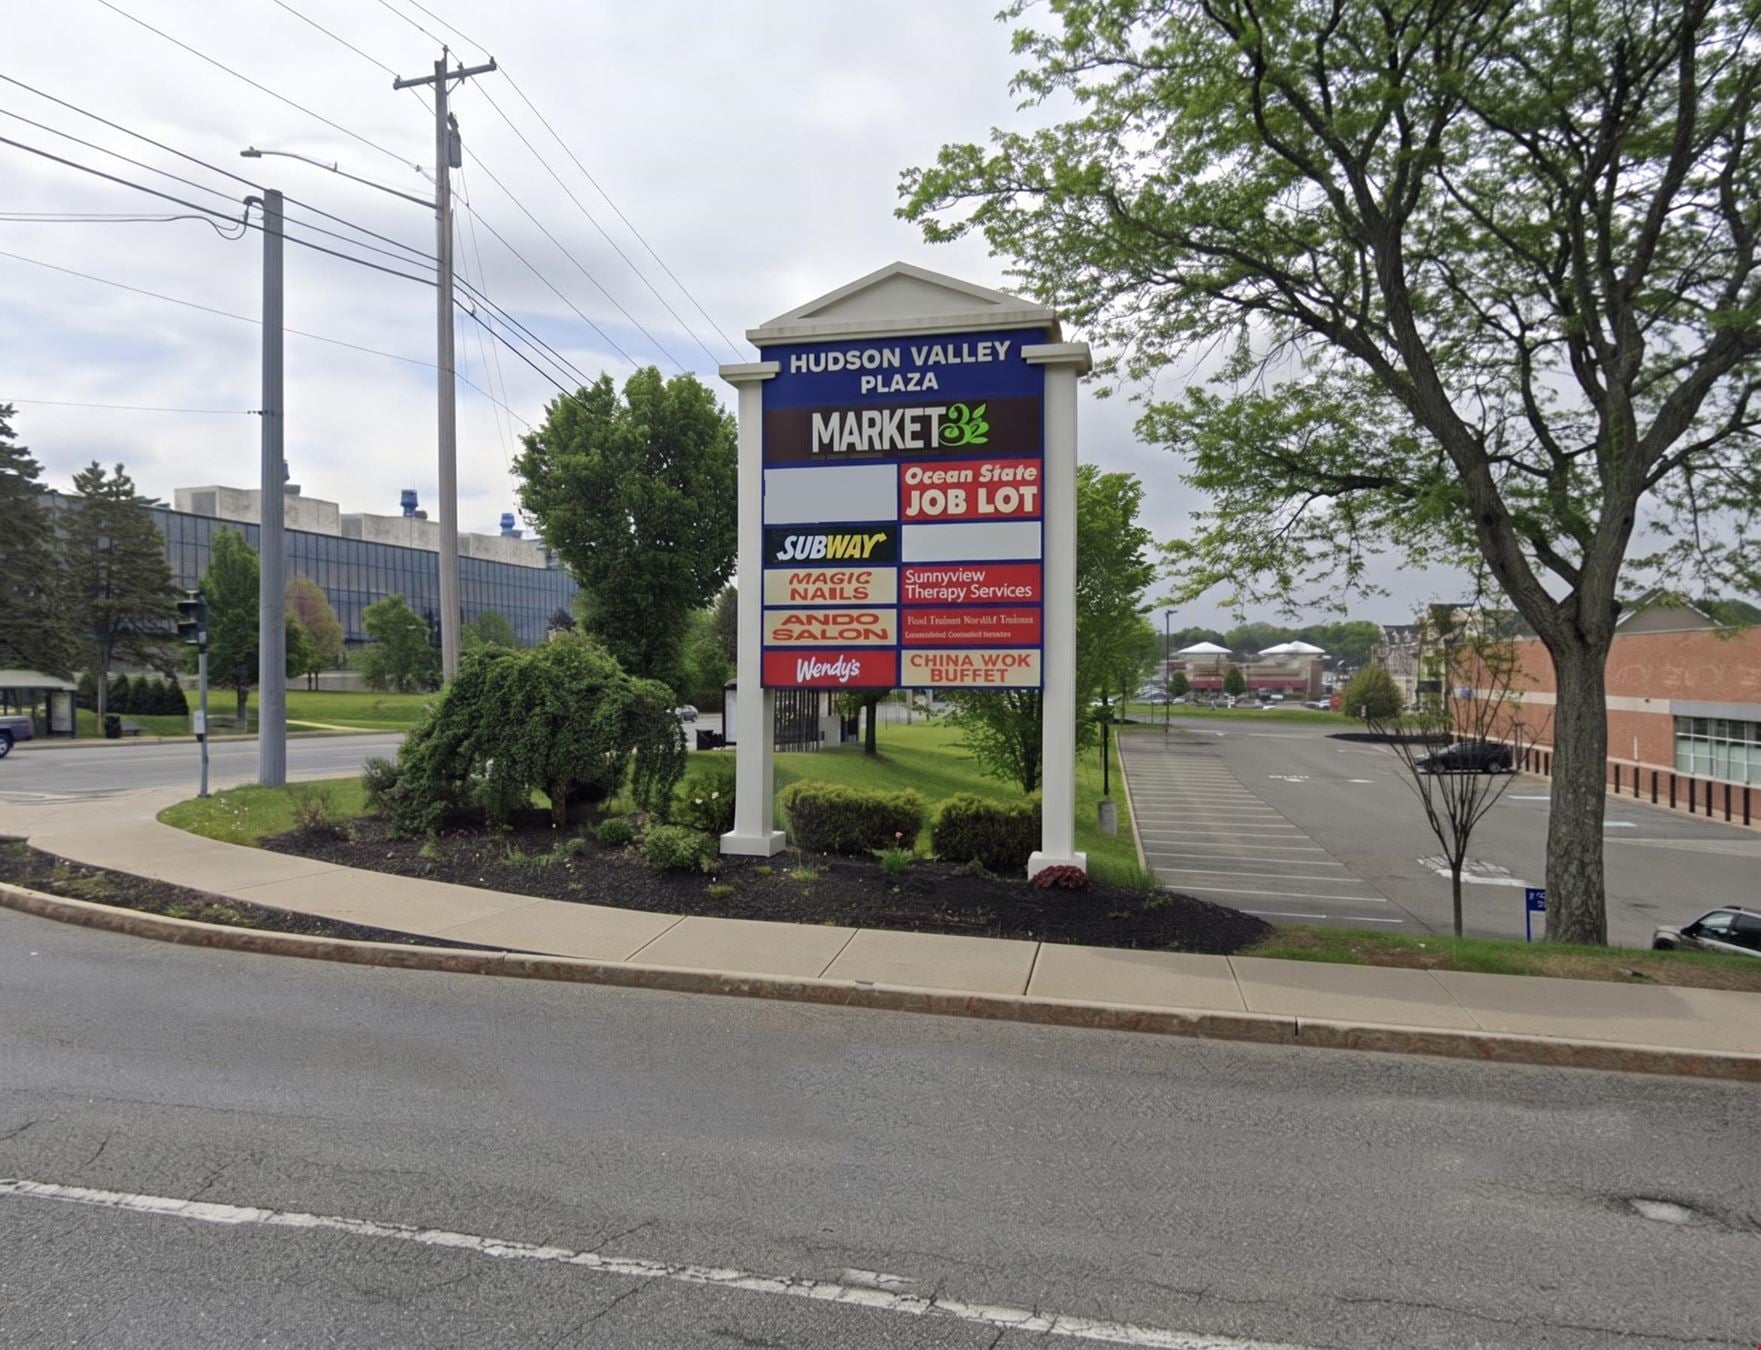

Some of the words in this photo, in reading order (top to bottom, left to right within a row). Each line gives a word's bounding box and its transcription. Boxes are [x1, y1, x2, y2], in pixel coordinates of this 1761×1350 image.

[790, 348, 900, 374] HUDSON
[911, 340, 1011, 366] VALLEY
[861, 372, 939, 394] PLAZA
[812, 406, 947, 453] MARKET
[905, 467, 973, 485] Ocean
[978, 464, 1037, 483] State
[905, 488, 967, 516] JOB
[977, 485, 1038, 514] LOT
[776, 532, 887, 561] SUBWAY
[789, 571, 872, 585] MAGIC
[905, 568, 986, 586] Sunnyview
[790, 586, 870, 601] NAILS
[905, 585, 966, 602] Therapy
[970, 583, 1033, 599] Services
[780, 613, 880, 626] ANDO
[772, 627, 889, 641] SALON
[796, 654, 860, 683] Wendy's
[910, 654, 974, 668] CHINA
[980, 653, 1031, 667] WOK
[930, 668, 1009, 683] BUFFET
